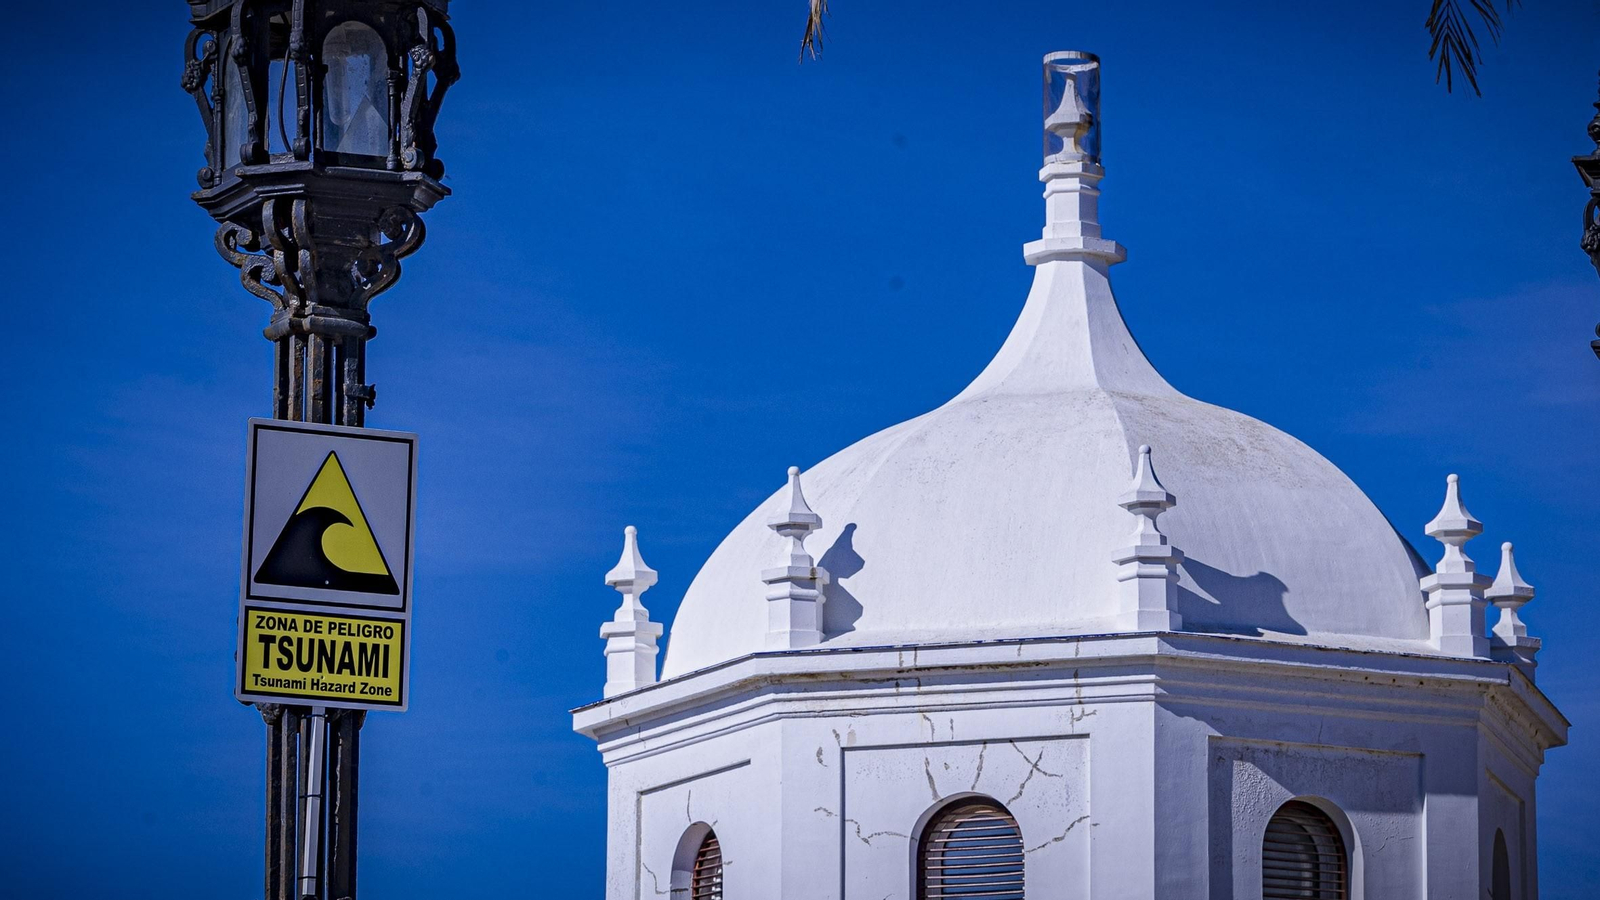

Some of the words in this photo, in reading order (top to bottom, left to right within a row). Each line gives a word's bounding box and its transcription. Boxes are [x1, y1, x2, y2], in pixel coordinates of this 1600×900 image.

[255, 615, 298, 632] ZONA
[303, 619, 323, 634] DE
[327, 621, 394, 640] PELIGRO
[258, 634, 390, 678] TSUNAMI
[252, 673, 306, 690] Tsunami
[310, 678, 356, 694] Hazard
[359, 682, 393, 697] Zone
